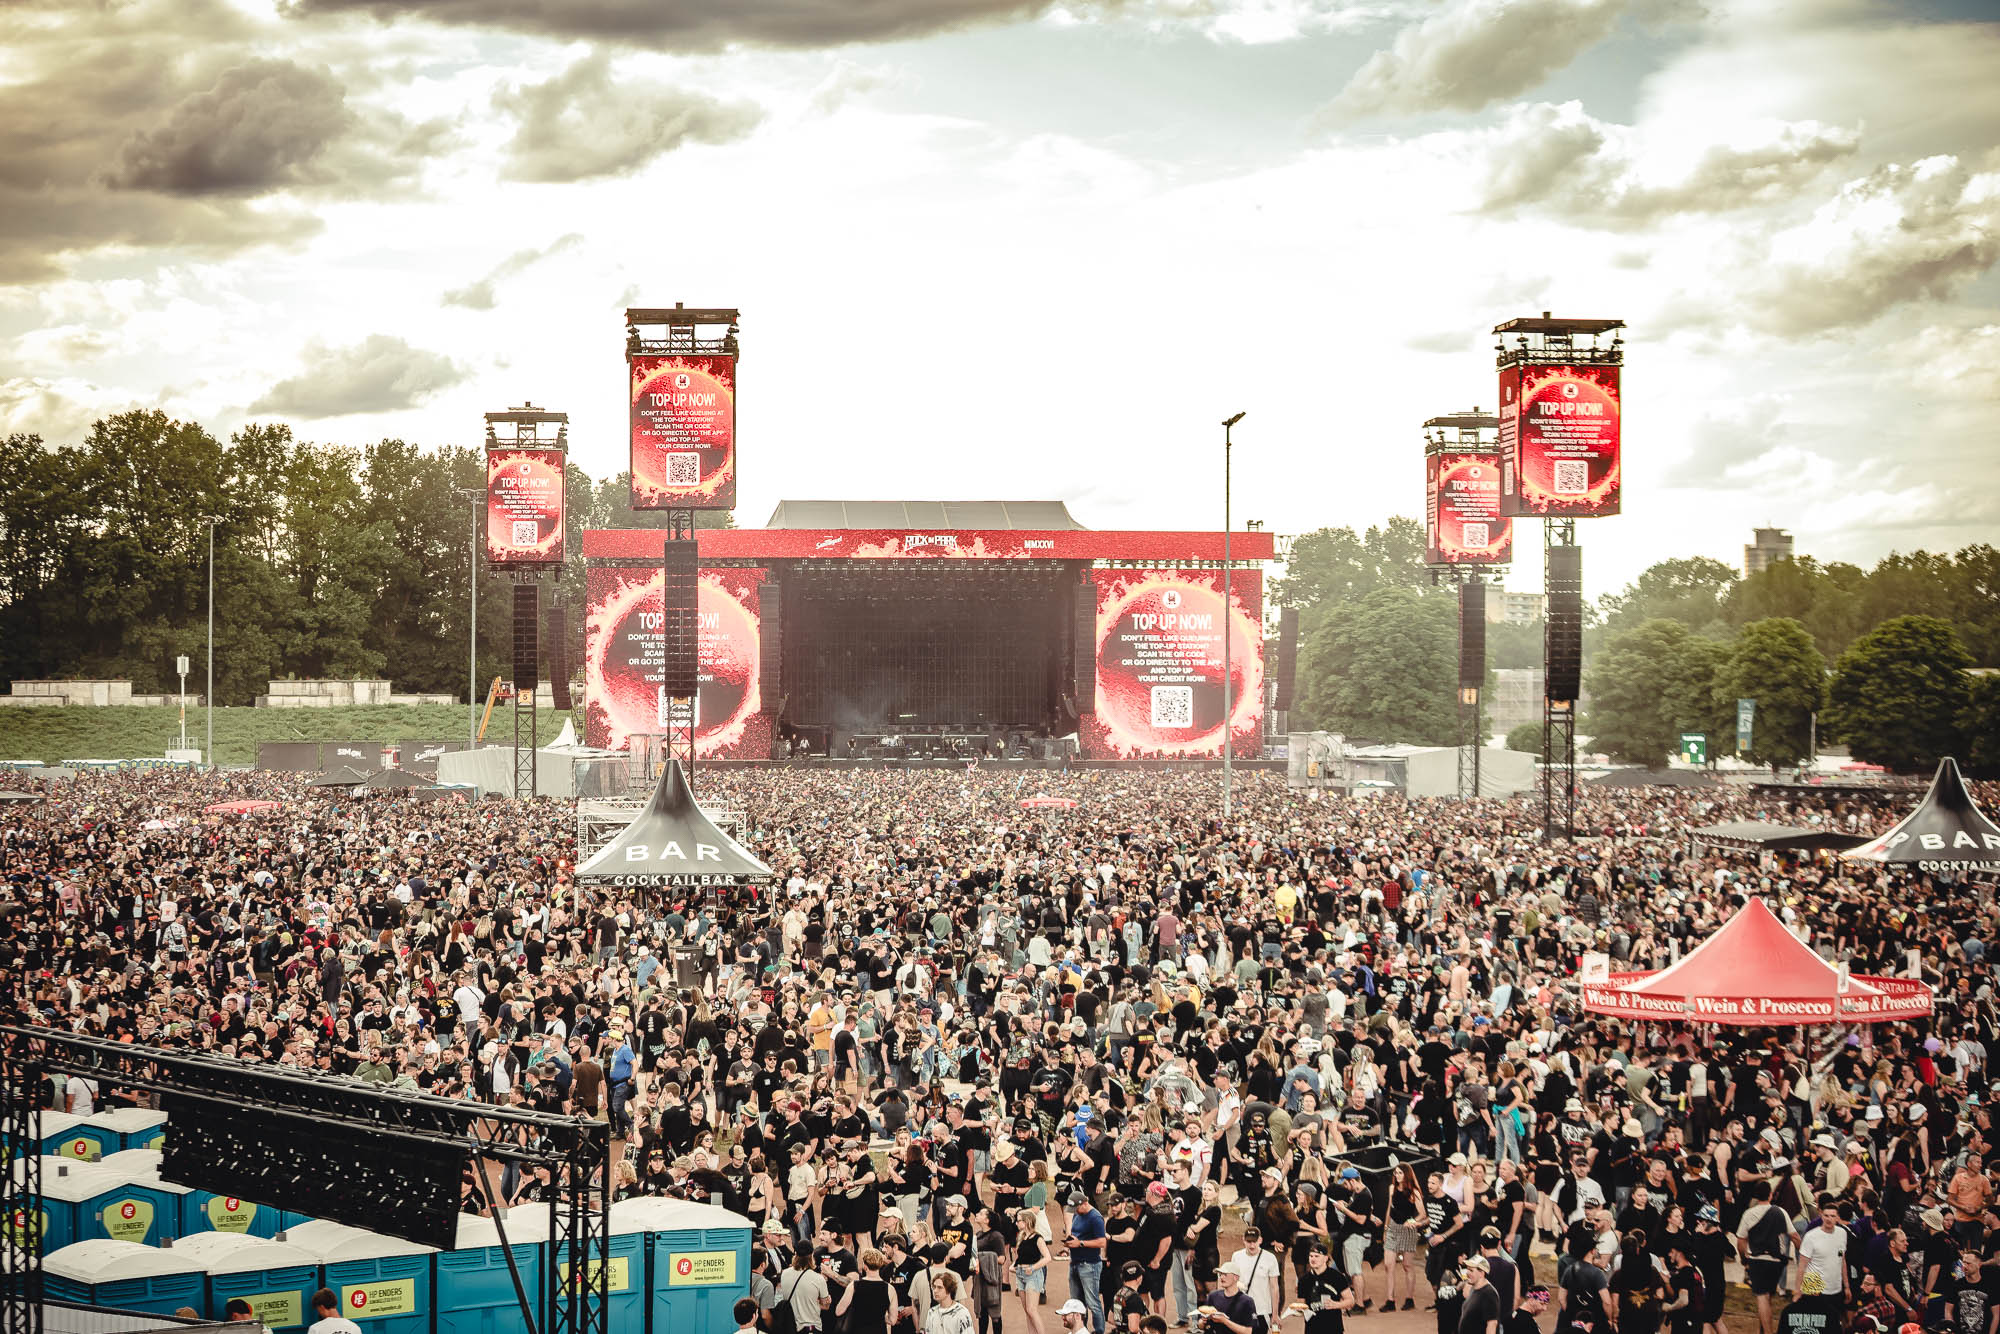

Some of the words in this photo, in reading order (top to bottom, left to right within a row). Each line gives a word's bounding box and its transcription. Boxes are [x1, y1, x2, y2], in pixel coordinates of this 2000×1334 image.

[650, 393, 670, 406] TOP
[673, 393, 687, 406] UP
[689, 393, 715, 406] NOW!
[1538, 402, 1559, 415] TOP
[1560, 402, 1575, 416] UP
[1576, 403, 1603, 416] NOW!
[502, 478, 516, 488] TOP
[518, 478, 528, 488] UP
[905, 536, 928, 551] ROCK
[935, 536, 958, 550] PARK
[1024, 540, 1054, 549] MMXXVI
[639, 613, 664, 629] TOP
[1132, 614, 1157, 630] TOP
[1160, 614, 1176, 630] UP
[1180, 614, 1212, 630] NOW!
[1920, 830, 2000, 850] BAR
[626, 841, 722, 861] BAR
[614, 874, 735, 886] COCKTAILBAR
[1586, 990, 1616, 1007] Wein
[1619, 992, 1630, 1008] &
[1632, 994, 1684, 1013] Prosecco
[1696, 998, 1738, 1014] Wein
[1741, 998, 1756, 1014] &
[1760, 998, 1831, 1014] Prosecco
[1871, 997, 1880, 1011] &
[1883, 994, 1929, 1008] Prosecco
[122, 1222, 144, 1230] ENDERS
[703, 1259, 724, 1267] ENDERS
[369, 1290, 377, 1298] HP
[379, 1288, 402, 1297] ENDERS
[264, 1300, 288, 1309] ENDERS
